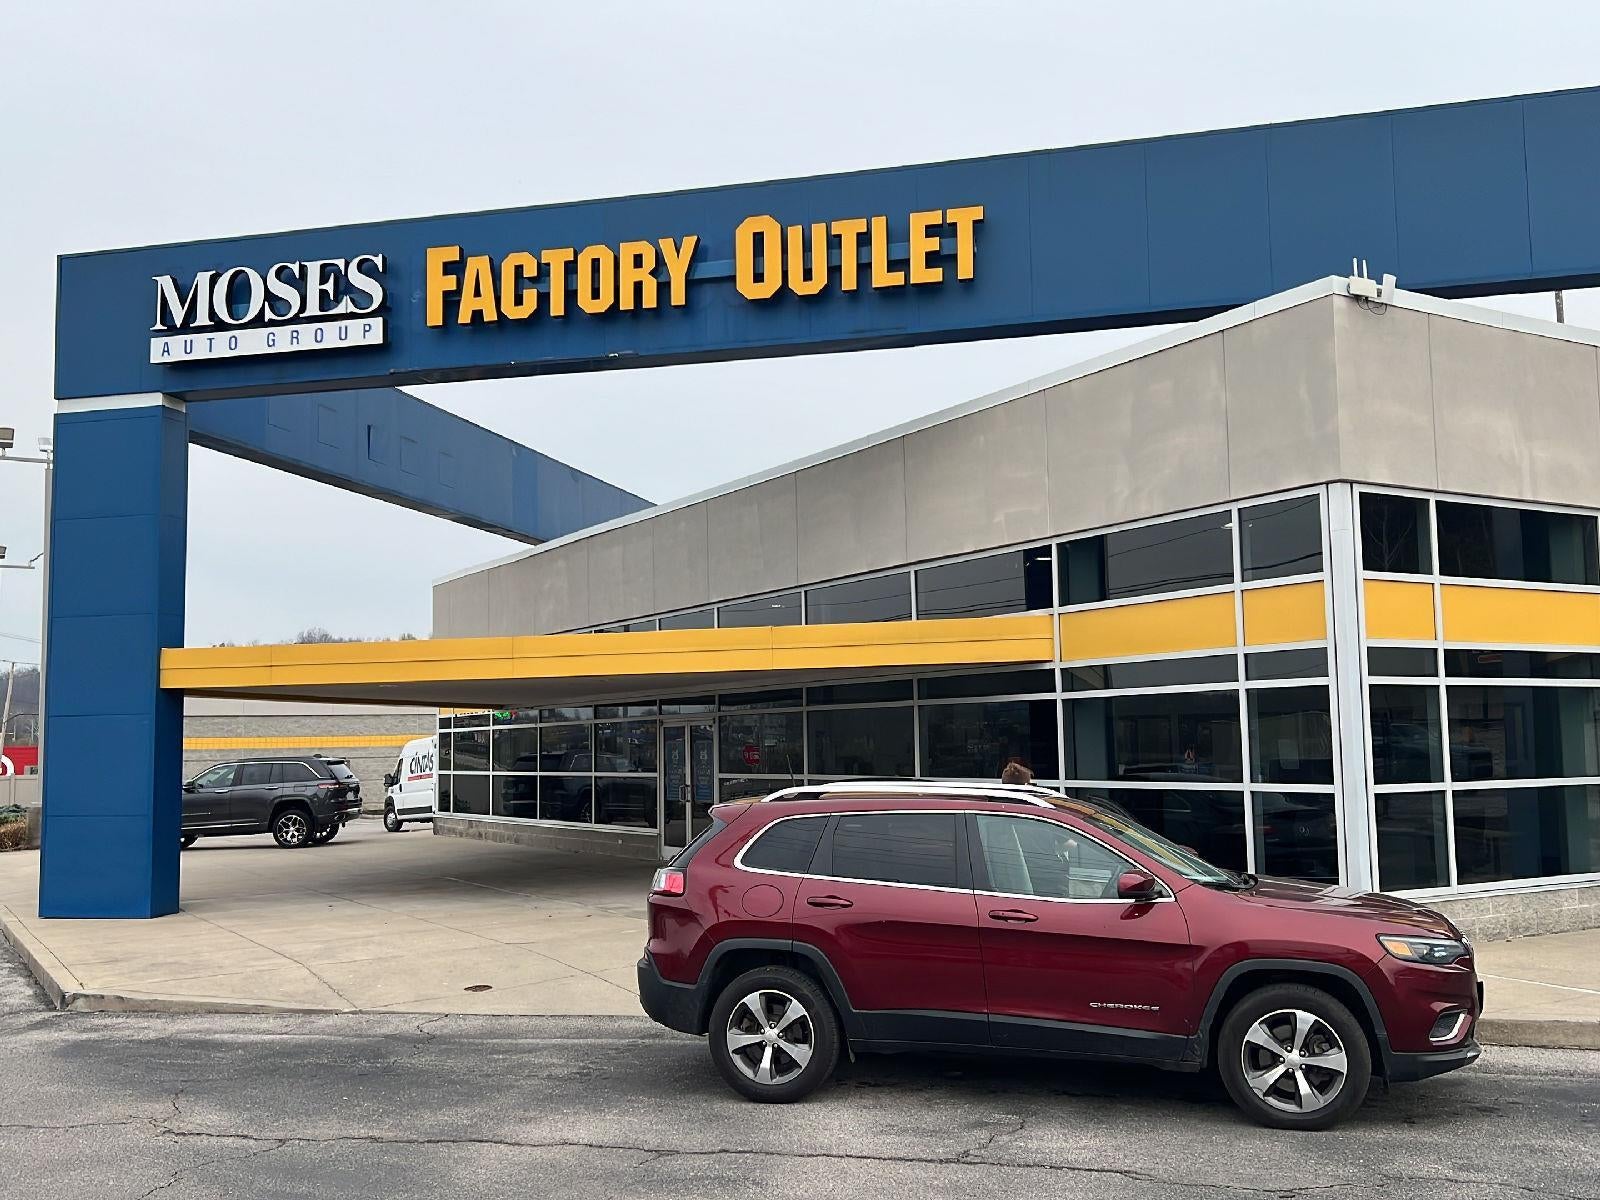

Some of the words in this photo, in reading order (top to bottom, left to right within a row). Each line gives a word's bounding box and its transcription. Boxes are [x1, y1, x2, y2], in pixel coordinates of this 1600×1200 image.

[150, 253, 384, 331] MOSES
[426, 235, 698, 327] FACTORY
[735, 205, 984, 300] OUTLET
[161, 335, 239, 357] AUTO
[266, 323, 373, 348] GROUP
[1089, 1002, 1160, 1011] CHEROKEE
